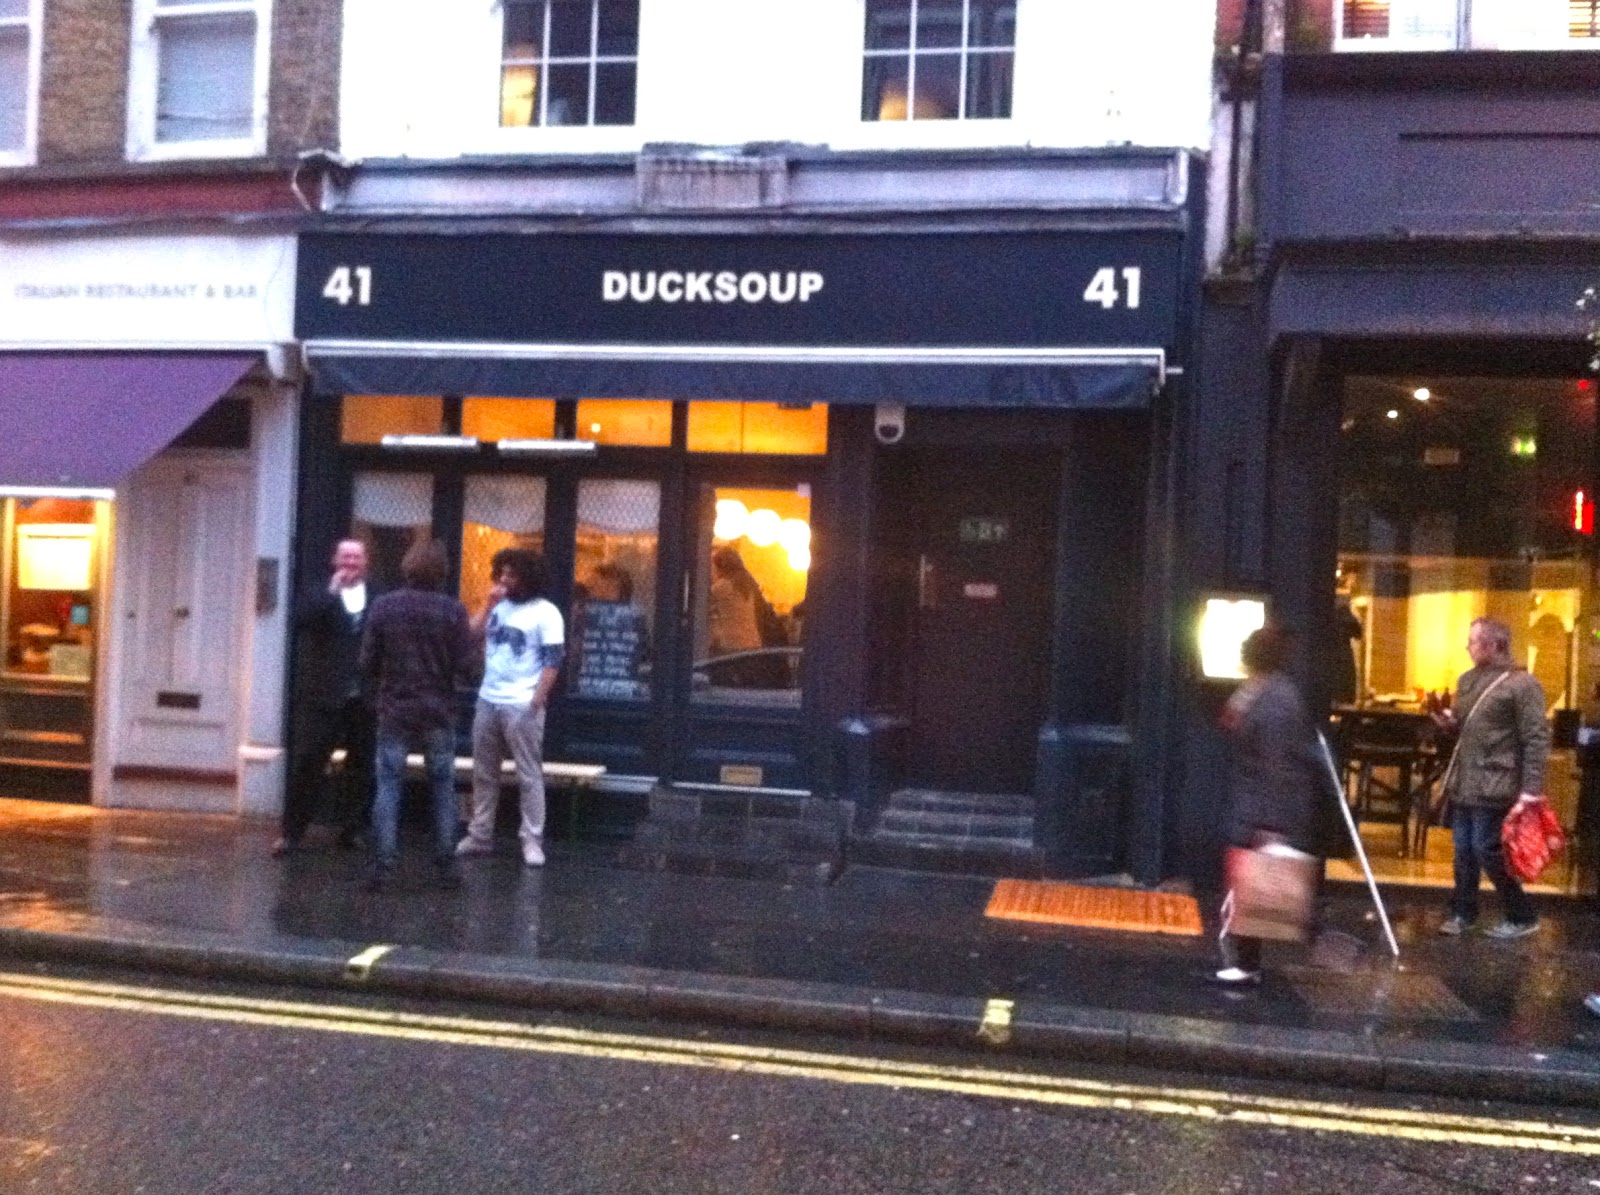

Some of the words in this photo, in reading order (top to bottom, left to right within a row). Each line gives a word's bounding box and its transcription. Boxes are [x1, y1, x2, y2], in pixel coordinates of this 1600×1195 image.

[85, 284, 197, 300] RESTAURANT
[205, 286, 217, 299] &
[223, 285, 257, 299] BAR
[322, 266, 372, 306] 41
[602, 270, 825, 304] DUCKSOUP
[1082, 266, 1142, 310] 41
